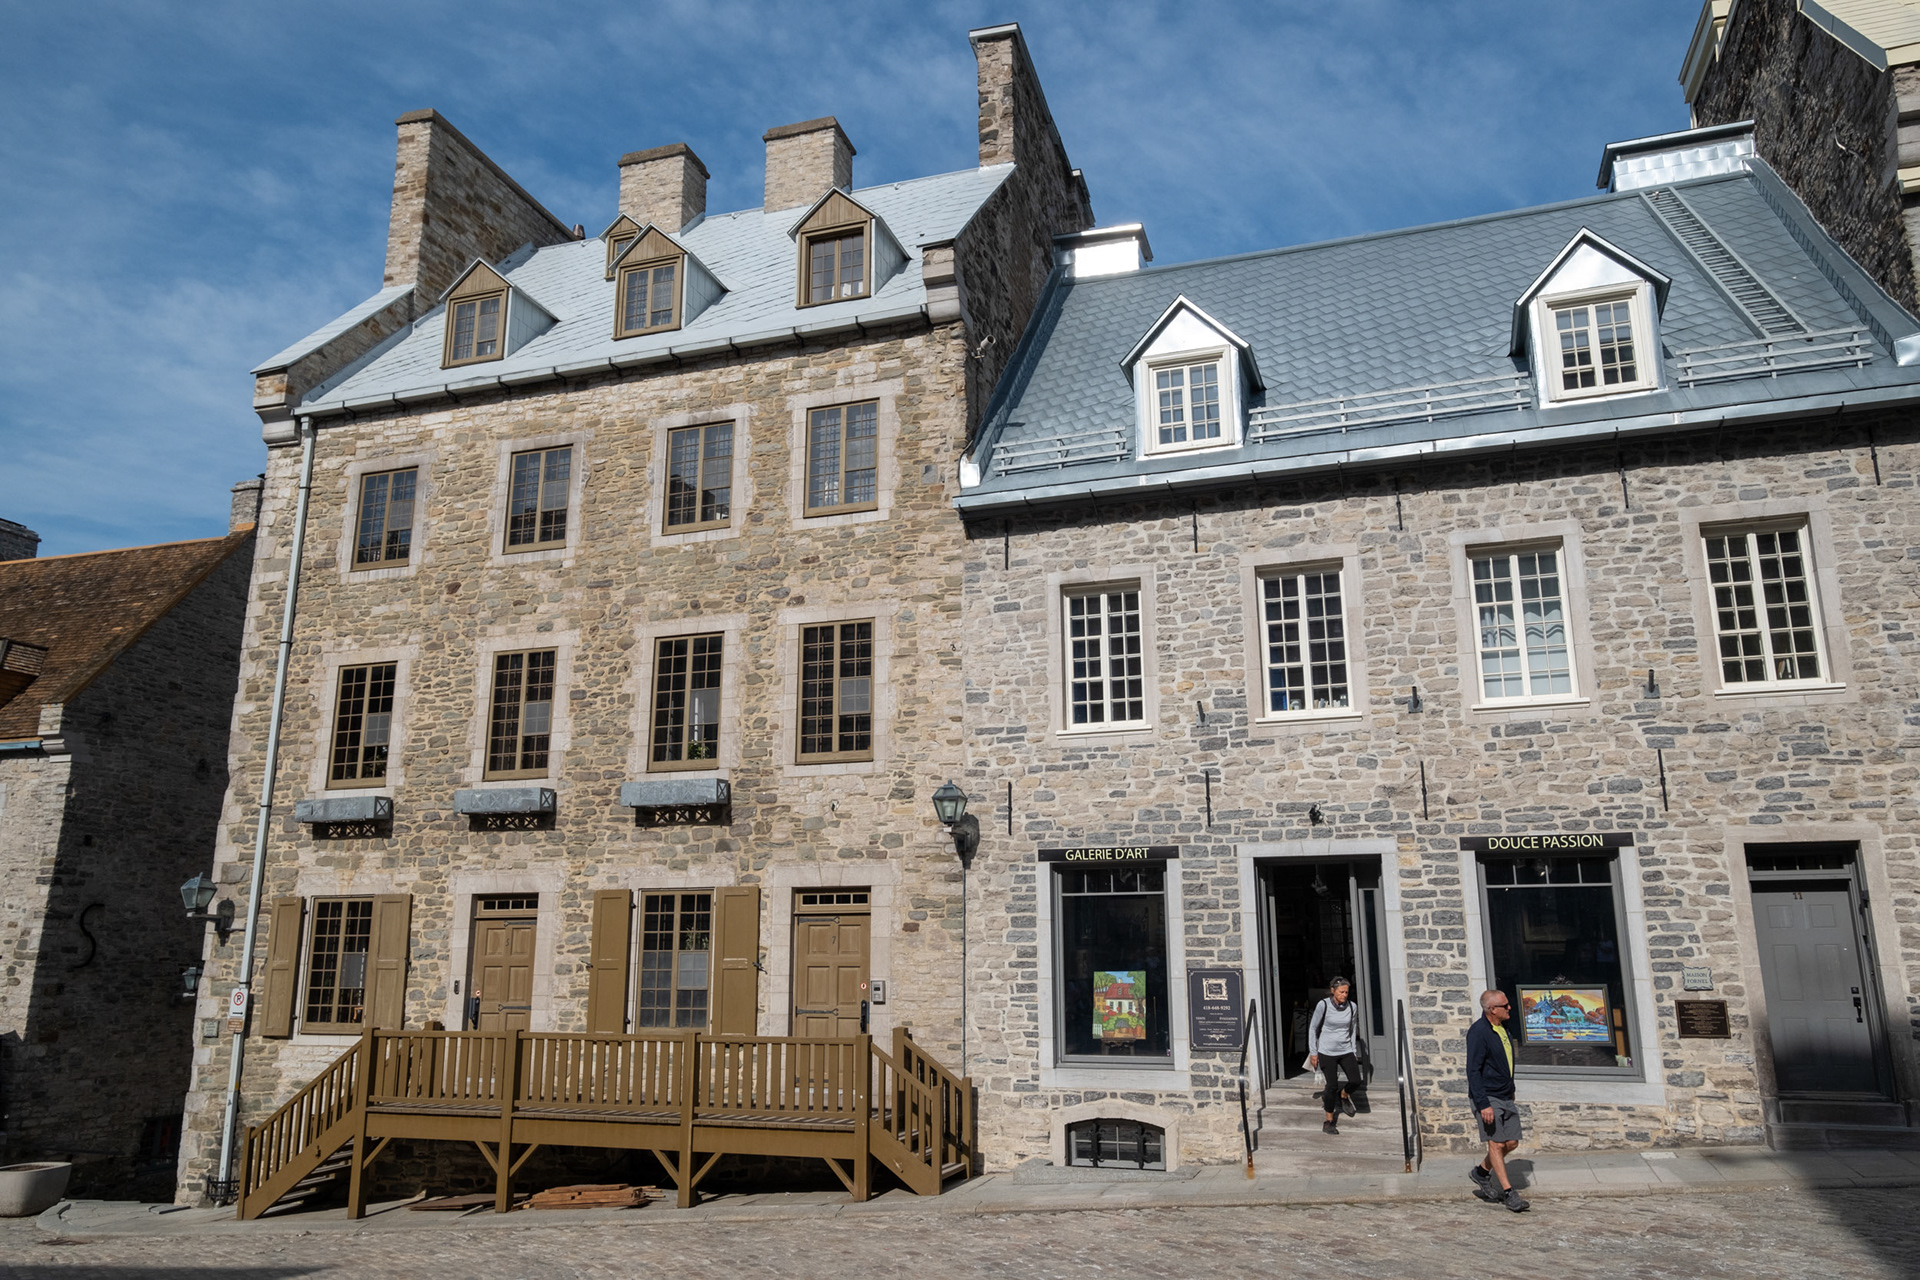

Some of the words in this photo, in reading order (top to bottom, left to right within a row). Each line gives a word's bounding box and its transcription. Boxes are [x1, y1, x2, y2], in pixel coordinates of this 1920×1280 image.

[1488, 836, 1540, 849] DOUCE
[1542, 834, 1604, 848] PASSION
[1065, 849, 1112, 860] GALERIE
[1115, 847, 1149, 859] D'ART
